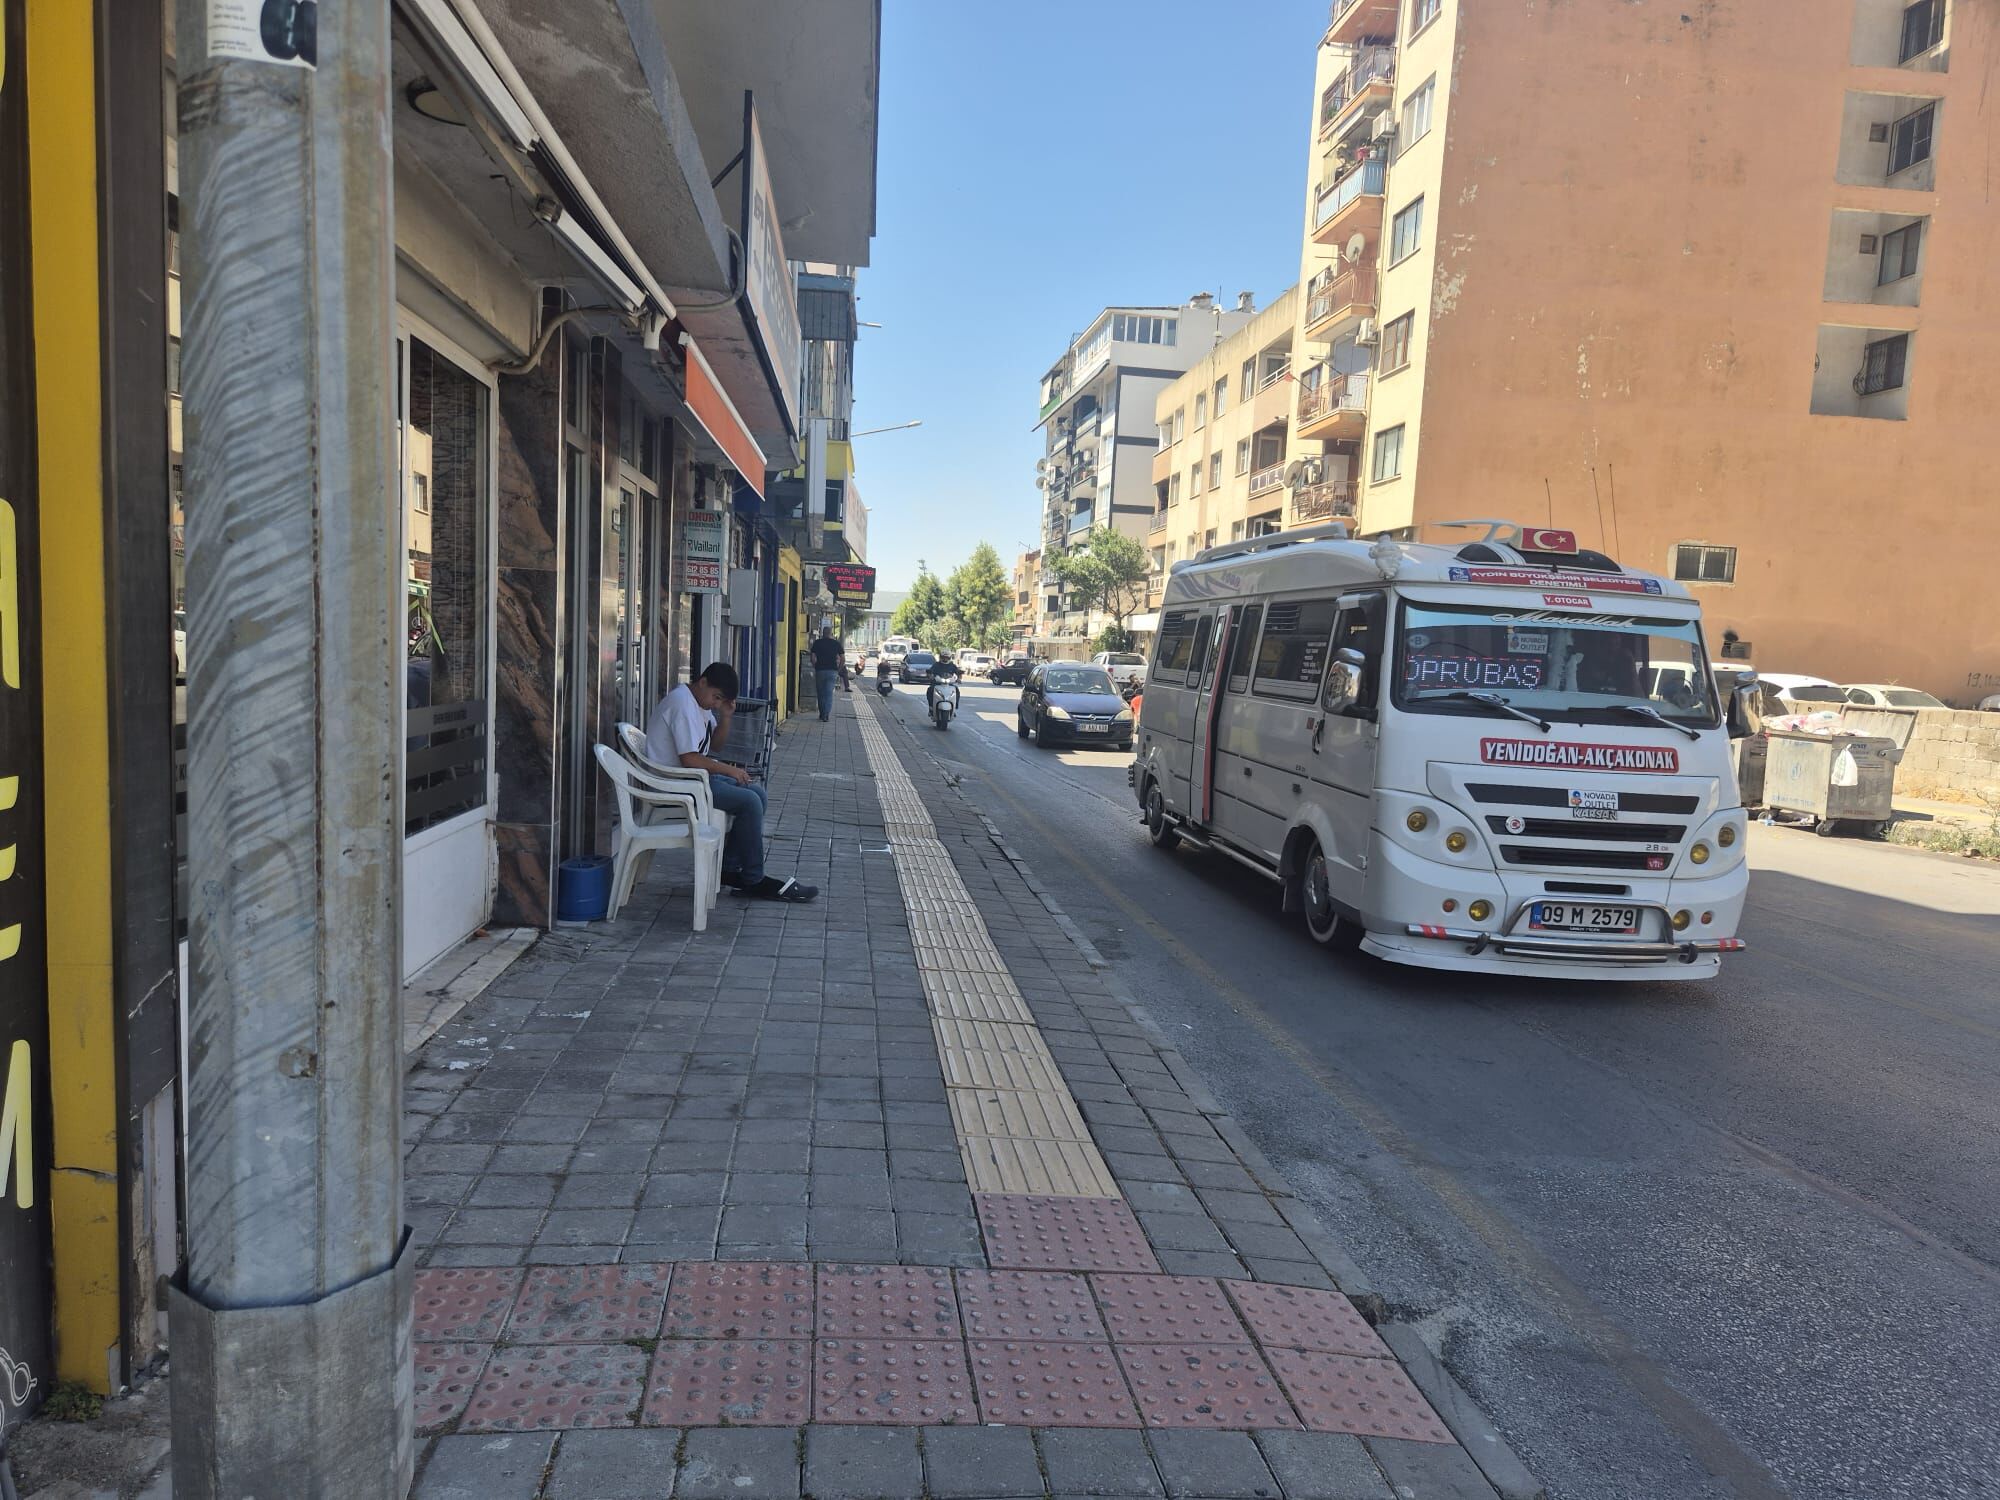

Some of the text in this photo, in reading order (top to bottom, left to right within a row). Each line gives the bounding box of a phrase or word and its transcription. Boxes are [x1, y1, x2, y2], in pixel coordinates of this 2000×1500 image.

[694, 540, 720, 553] Vaillant
[1554, 597, 1589, 606] OTOGAR
[1520, 643, 1546, 651] OUTLET
[1485, 741, 1675, 769] YENİDOĞAN-AKÇAKONAK
[1584, 792, 1616, 801] NOVADA
[1584, 800, 1616, 809] OUTLET
[1573, 807, 1618, 820] KARSAN
[1541, 905, 1564, 923] 09
[1571, 907, 1584, 925] M
[1591, 908, 1634, 927] 2579
